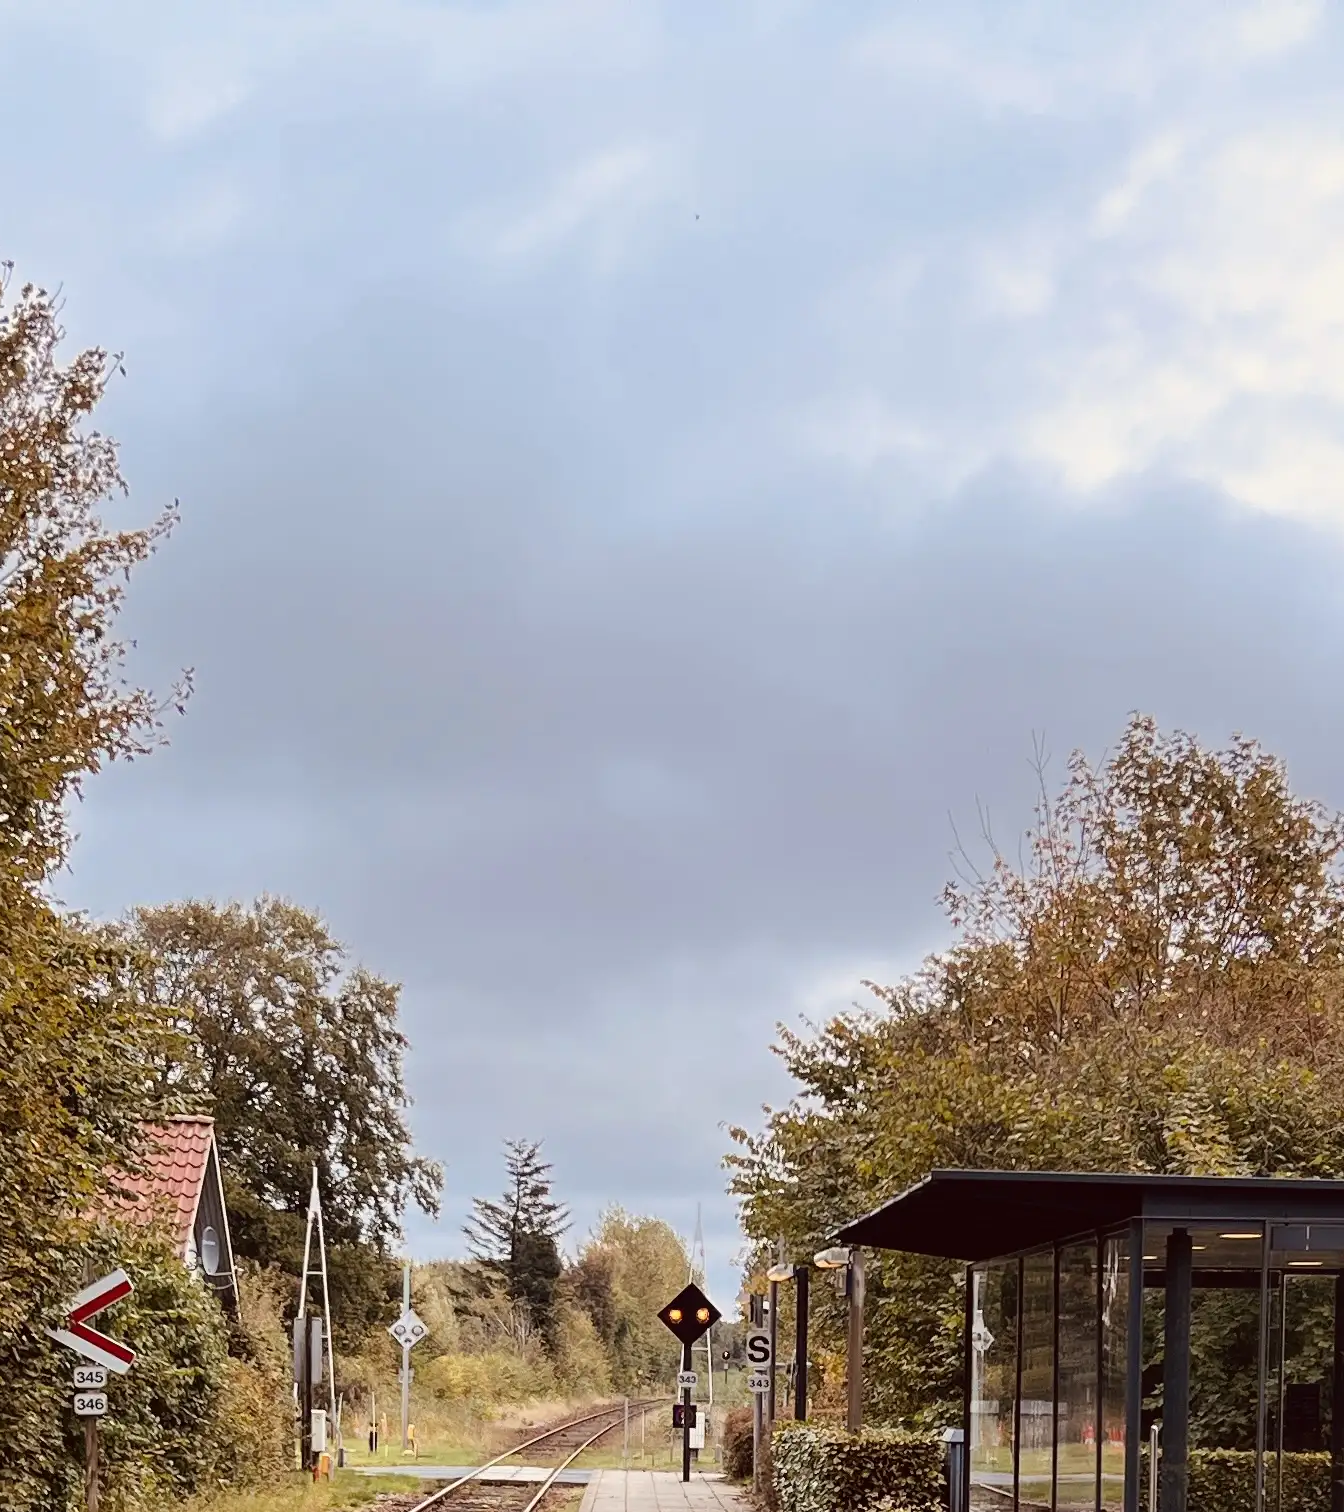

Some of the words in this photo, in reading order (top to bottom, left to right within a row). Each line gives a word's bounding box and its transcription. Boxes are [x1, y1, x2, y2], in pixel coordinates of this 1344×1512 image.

[747, 1335, 770, 1363] S
[76, 1371, 104, 1383] 345
[678, 1375, 696, 1384] 343
[749, 1379, 769, 1388] 343
[76, 1398, 104, 1410] 346
